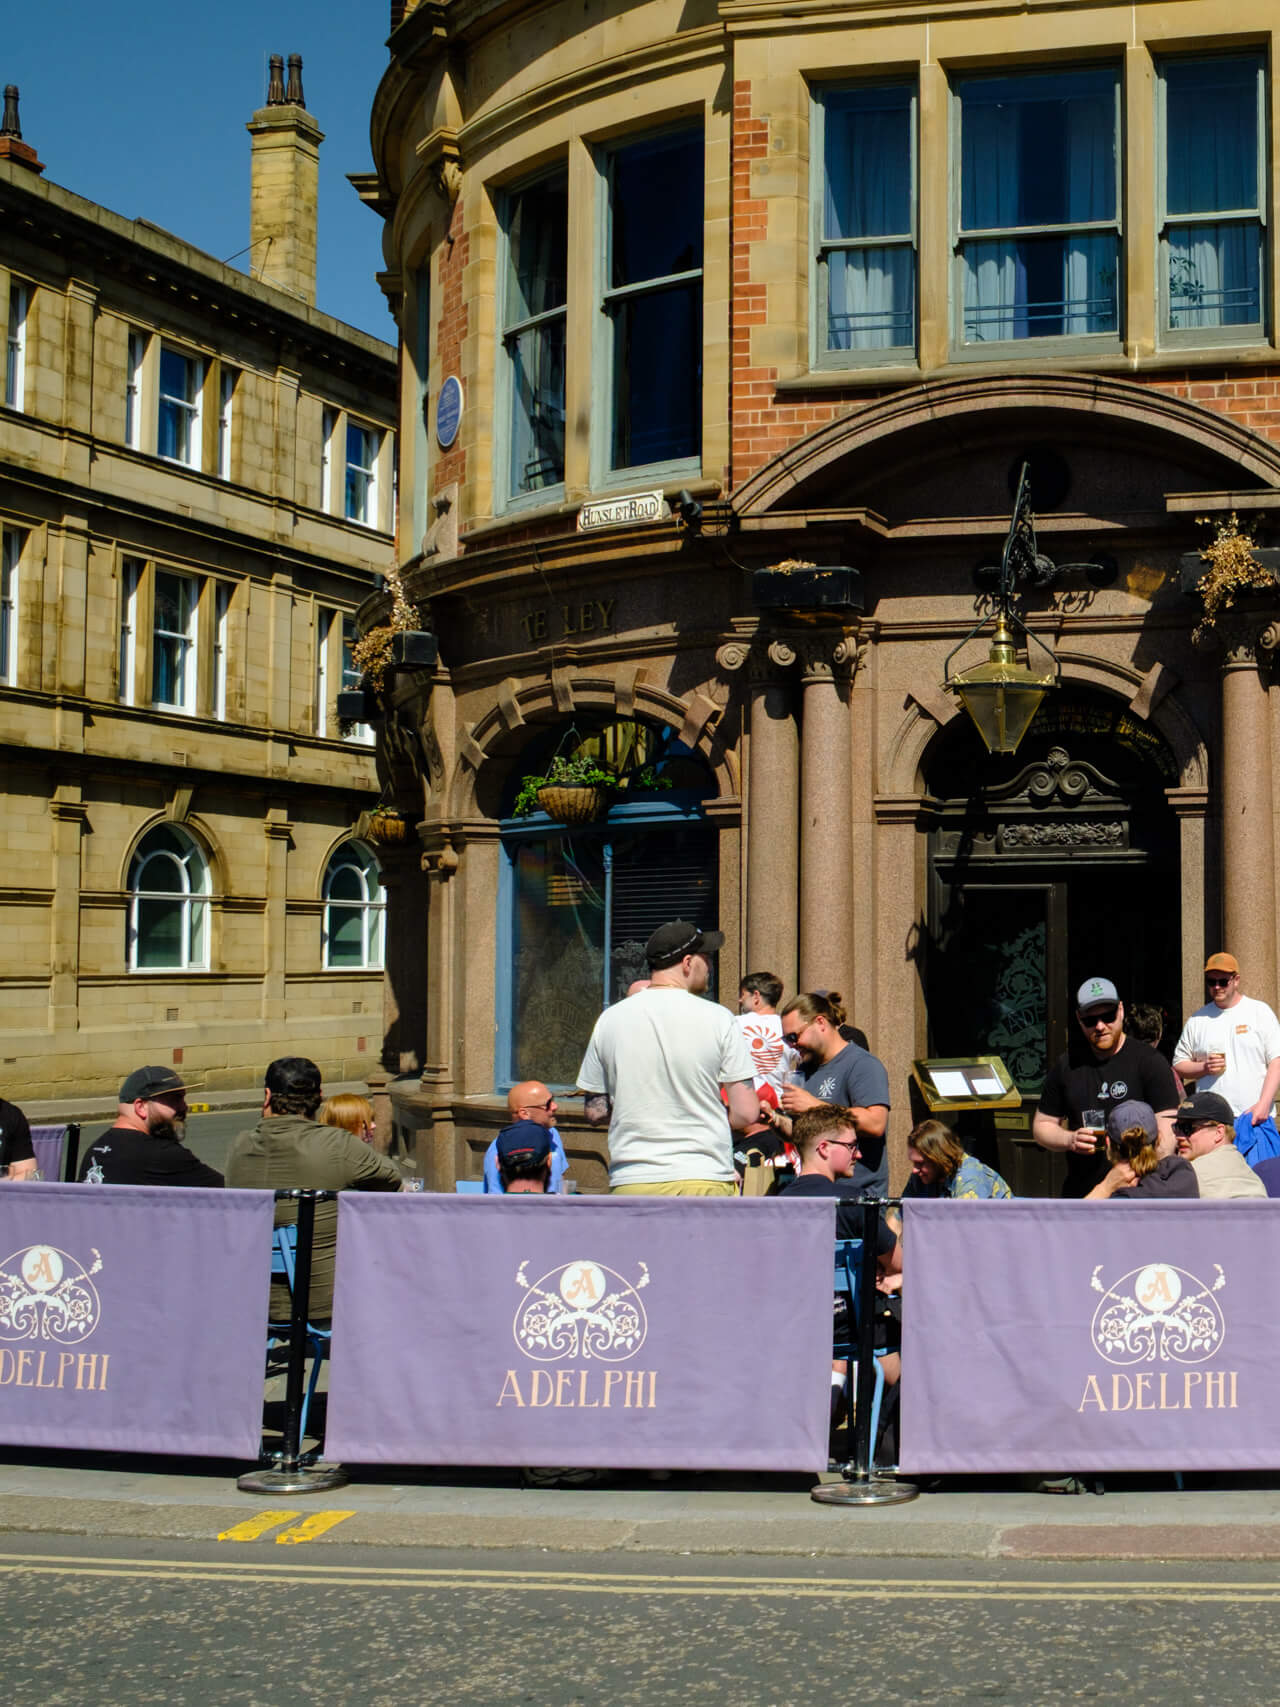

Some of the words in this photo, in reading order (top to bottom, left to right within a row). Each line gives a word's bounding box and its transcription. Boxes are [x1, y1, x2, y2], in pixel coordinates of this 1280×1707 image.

[583, 506, 629, 526] HUNSLET
[628, 500, 657, 520] ROAD
[27, 1252, 57, 1283] A
[566, 1268, 599, 1300] A
[1141, 1271, 1175, 1302] A
[0, 1348, 111, 1391] DELPHI
[495, 1369, 658, 1408] ADELPHI
[1077, 1371, 1239, 1413] ADELPHI
